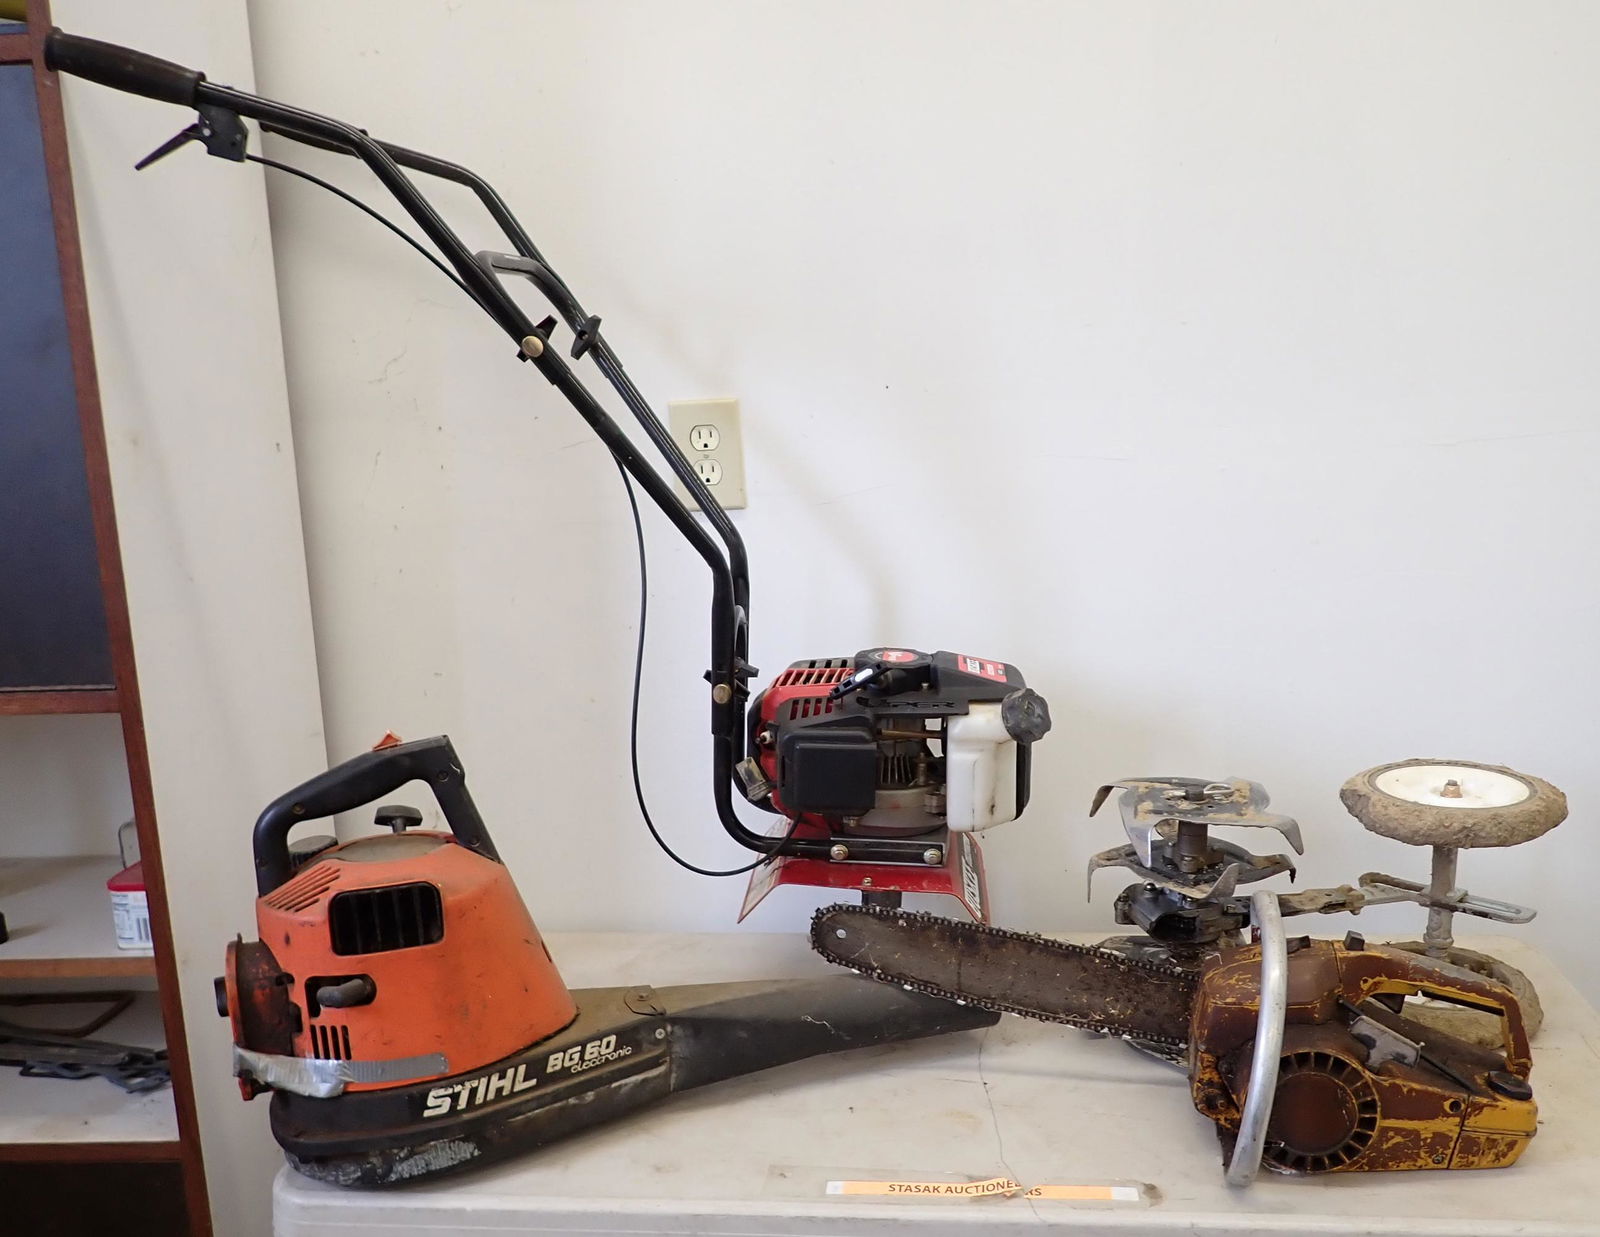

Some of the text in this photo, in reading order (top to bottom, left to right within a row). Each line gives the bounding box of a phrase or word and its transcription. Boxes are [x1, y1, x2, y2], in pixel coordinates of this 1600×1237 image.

[547, 1035, 616, 1073] BG 60
[423, 1064, 536, 1117] STIHL
[888, 1183, 941, 1194] STASAK
